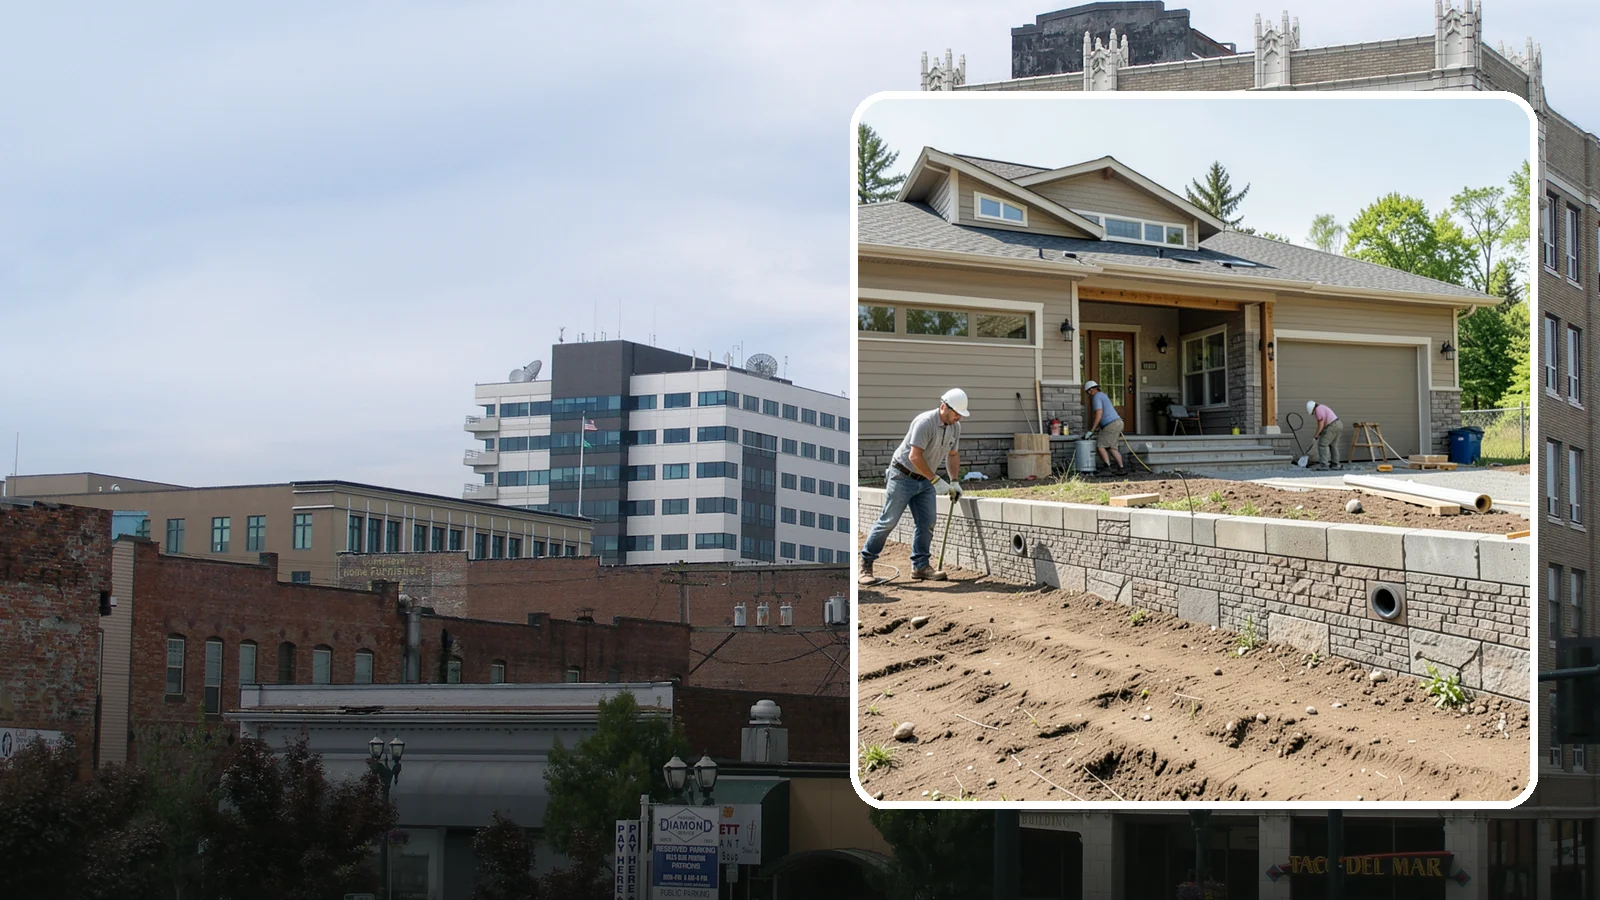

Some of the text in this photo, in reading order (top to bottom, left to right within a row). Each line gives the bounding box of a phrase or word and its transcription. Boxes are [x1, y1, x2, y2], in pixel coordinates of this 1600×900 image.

[370, 566, 427, 576] Furnishers
[660, 818, 713, 833] DIAMOND
[1022, 815, 1070, 828] BUILDING
[689, 846, 716, 854] PARKING
[617, 825, 625, 893] PAY HERE
[627, 824, 637, 893] PAY HERE
[721, 851, 739, 861] Soup
[671, 862, 701, 870] PATRONS
[1346, 855, 1384, 876] DEL
[1392, 857, 1442, 877] MAR
[660, 888, 710, 898] PUBLIC PARKING
